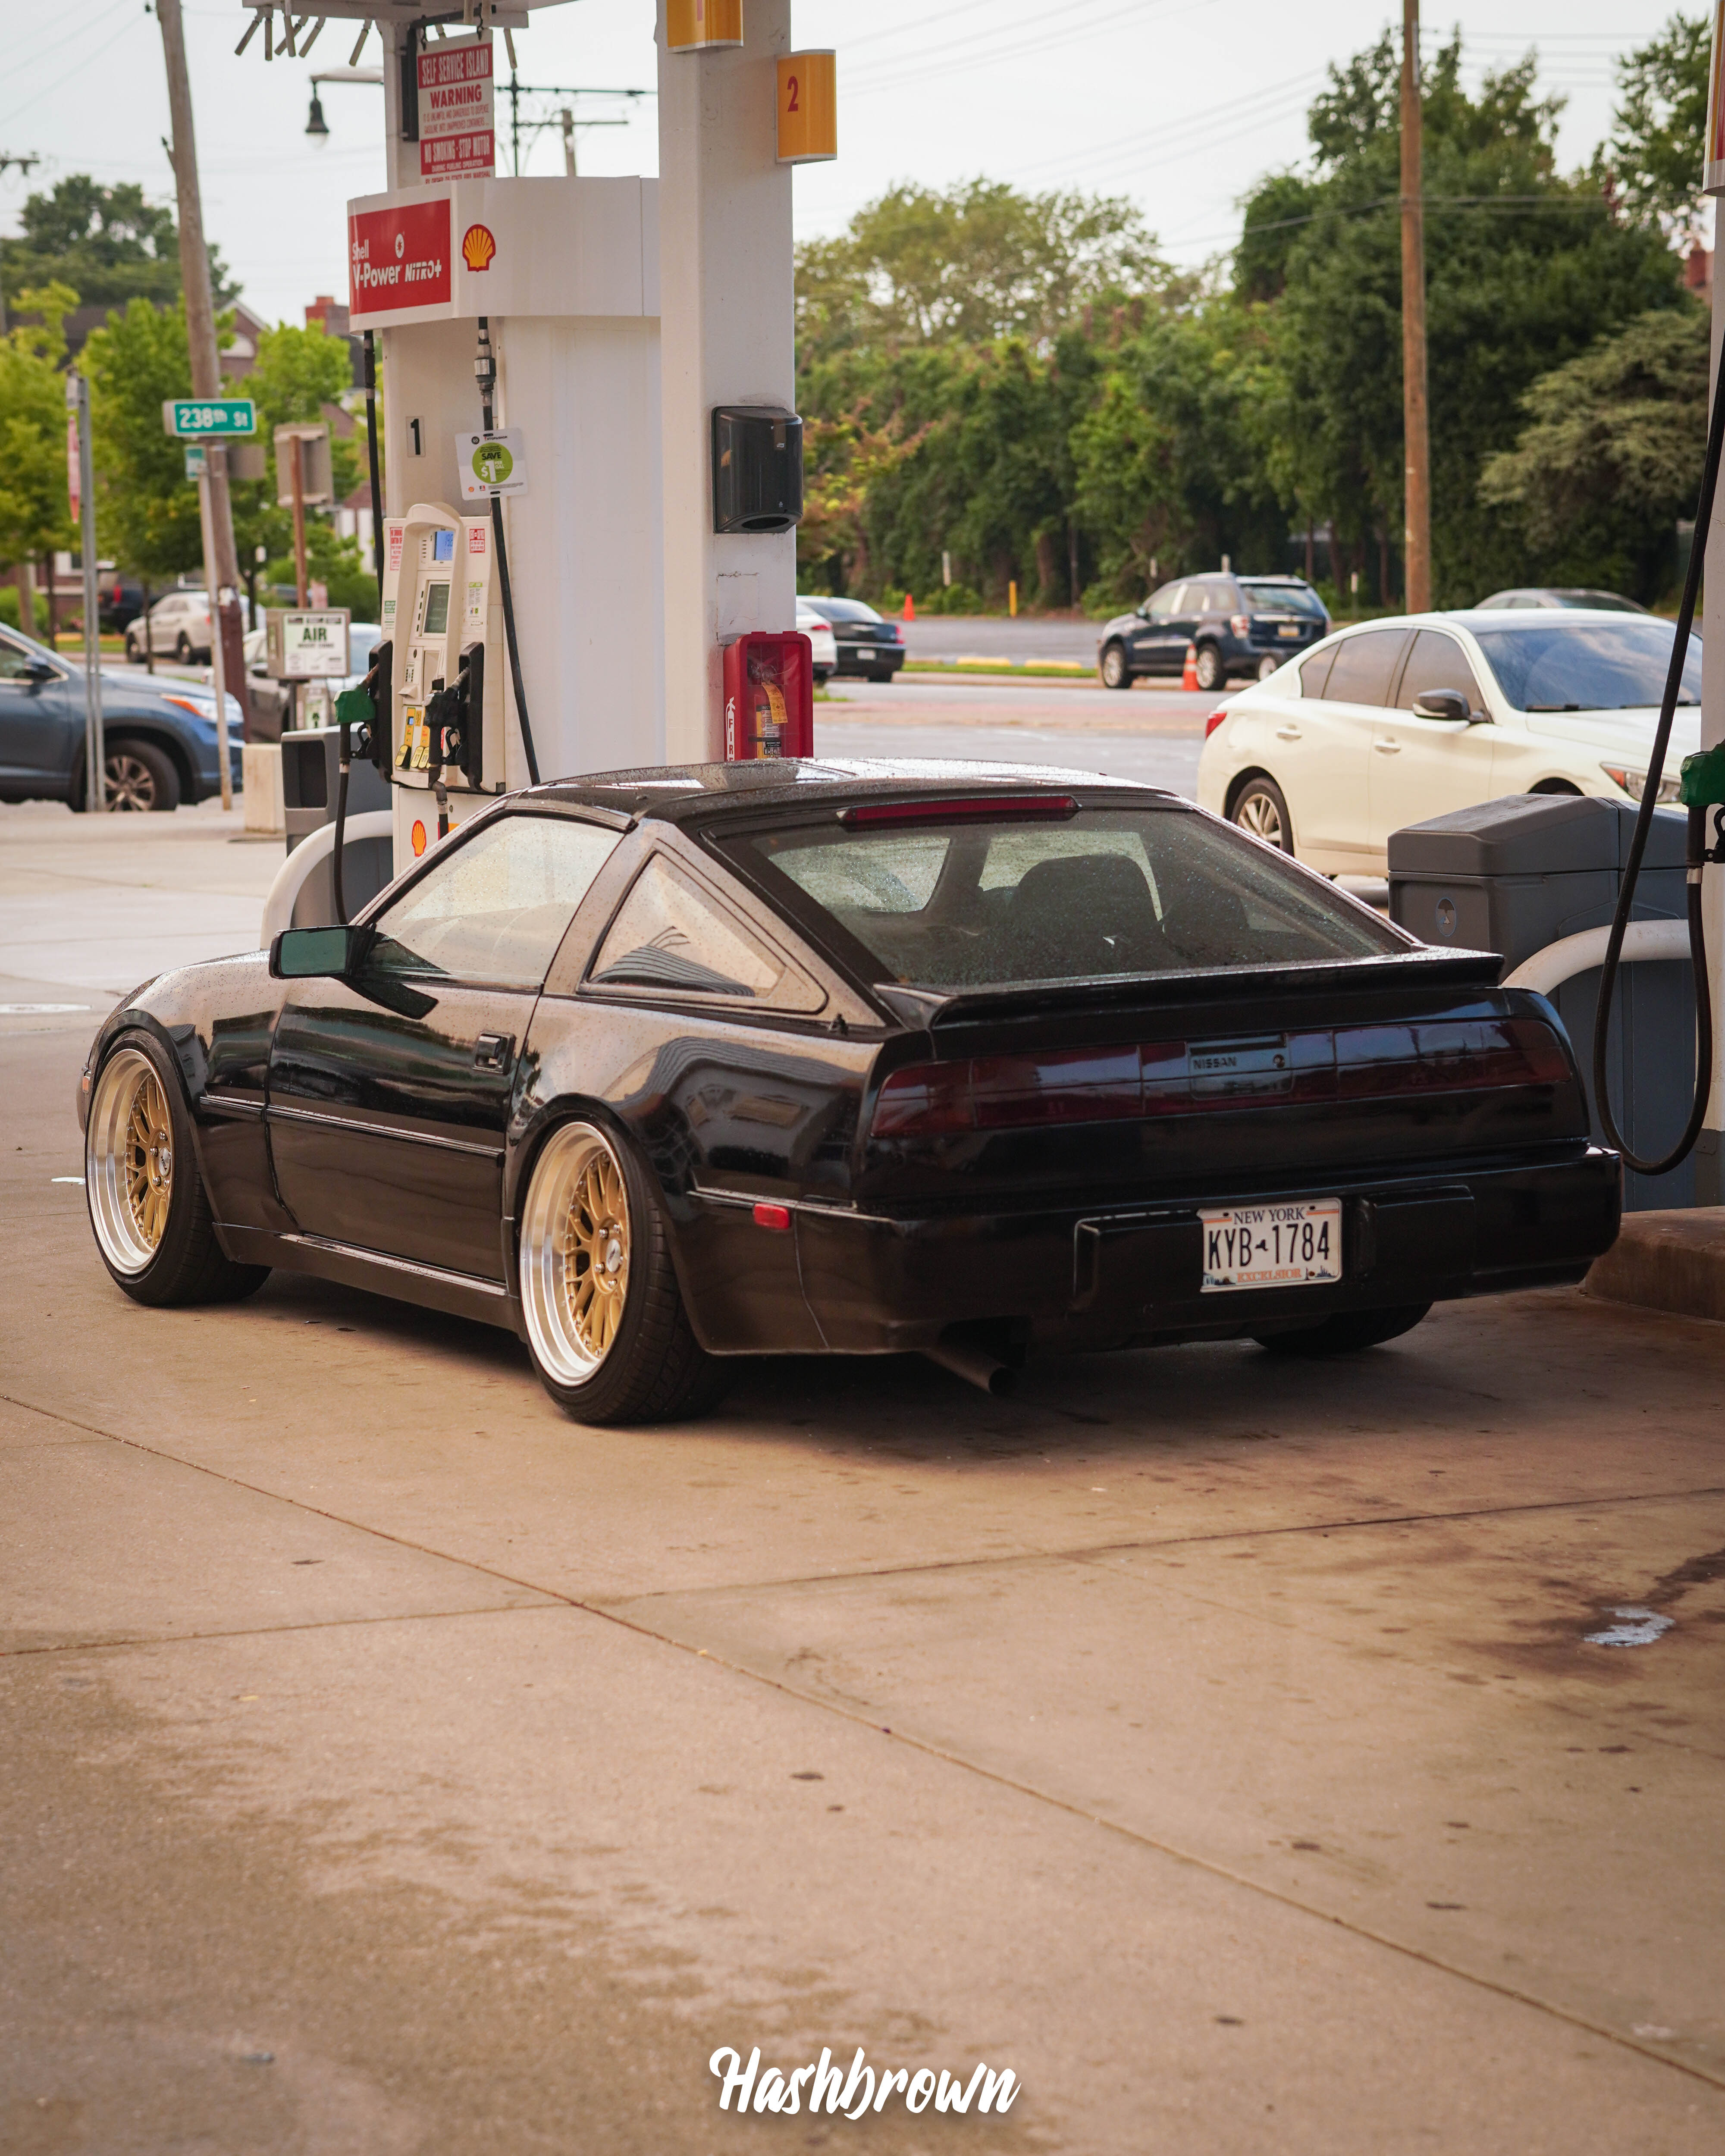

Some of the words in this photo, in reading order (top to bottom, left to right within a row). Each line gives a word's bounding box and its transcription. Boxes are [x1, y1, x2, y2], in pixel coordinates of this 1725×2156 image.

[422, 57, 436, 85] SELF
[439, 53, 464, 83] SERVICE
[466, 48, 489, 78] ISLAND
[430, 84, 482, 109] WARNING
[787, 75, 798, 112] 2
[424, 143, 432, 163] NO
[433, 139, 455, 162] SMOKING
[459, 137, 472, 159] STOP
[473, 135, 490, 157] MOTOR
[463, 159, 483, 169] OPERATION
[352, 239, 369, 261] Shell
[353, 262, 401, 290] V-Power
[179, 407, 228, 428] 238th
[410, 418, 420, 455] 1
[482, 452, 502, 460] SAVE
[303, 627, 327, 642] AIR
[1193, 1056, 1237, 1069] NISSAN
[1234, 1209, 1265, 1225] NEW
[1269, 1206, 1305, 1222] YORK
[1236, 1269, 1302, 1283] EXCELSIOR
